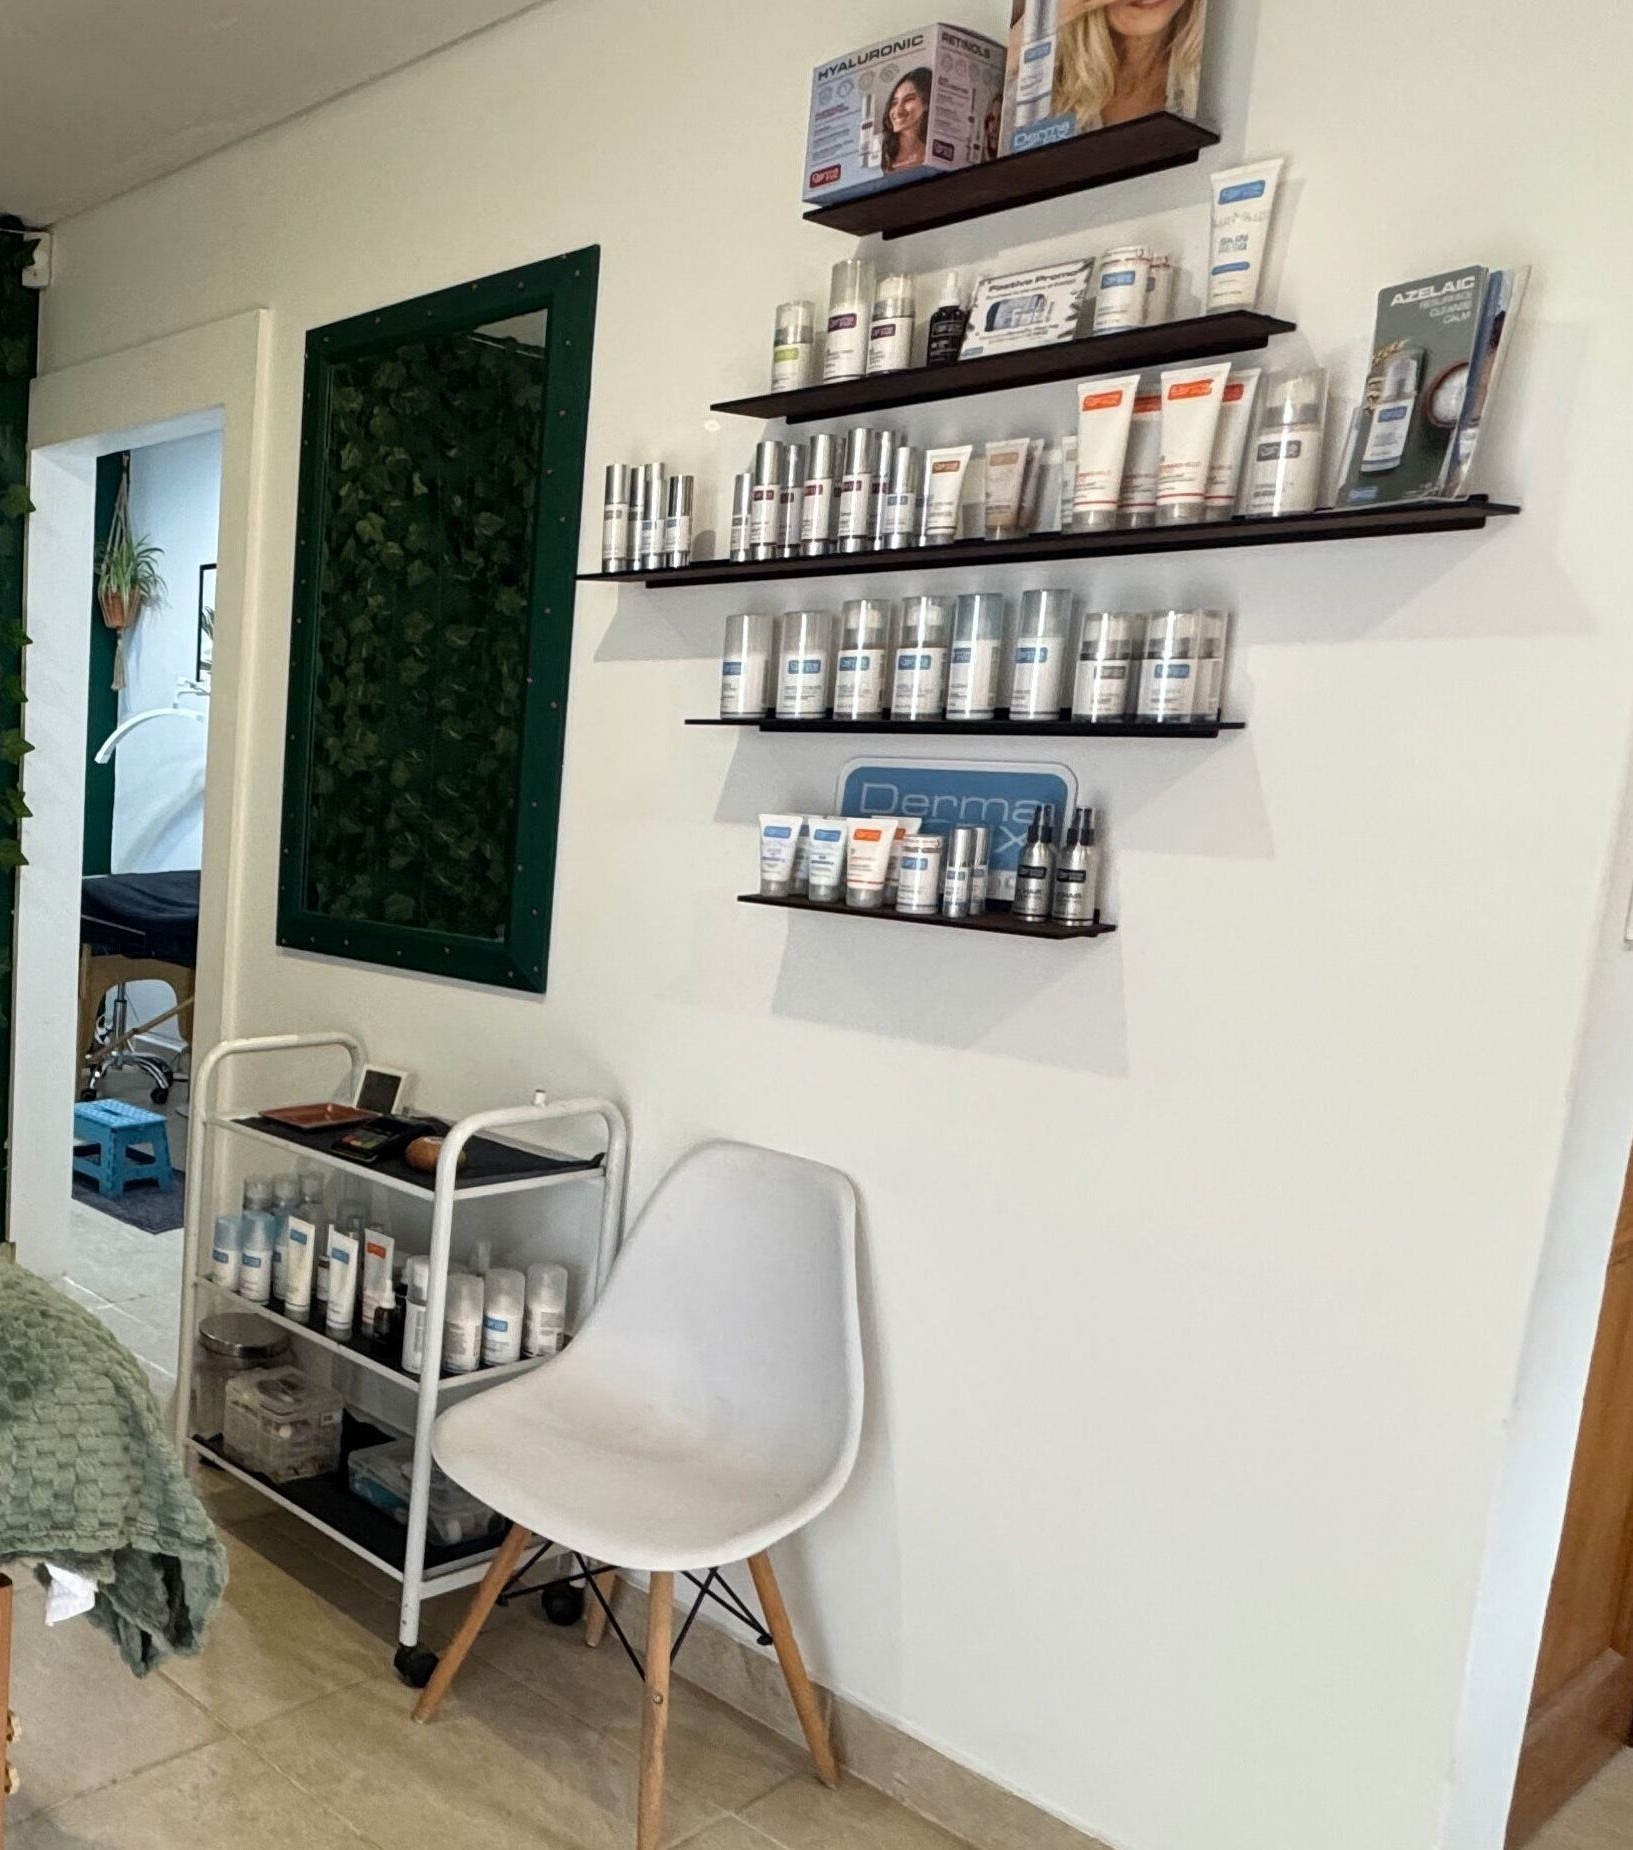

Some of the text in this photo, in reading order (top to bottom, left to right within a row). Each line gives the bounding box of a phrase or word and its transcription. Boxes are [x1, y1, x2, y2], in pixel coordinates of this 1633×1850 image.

[818, 34, 924, 81] HYALURONIC
[1390, 275, 1476, 307] AZELAIC
[859, 781, 1056, 824] Derma
